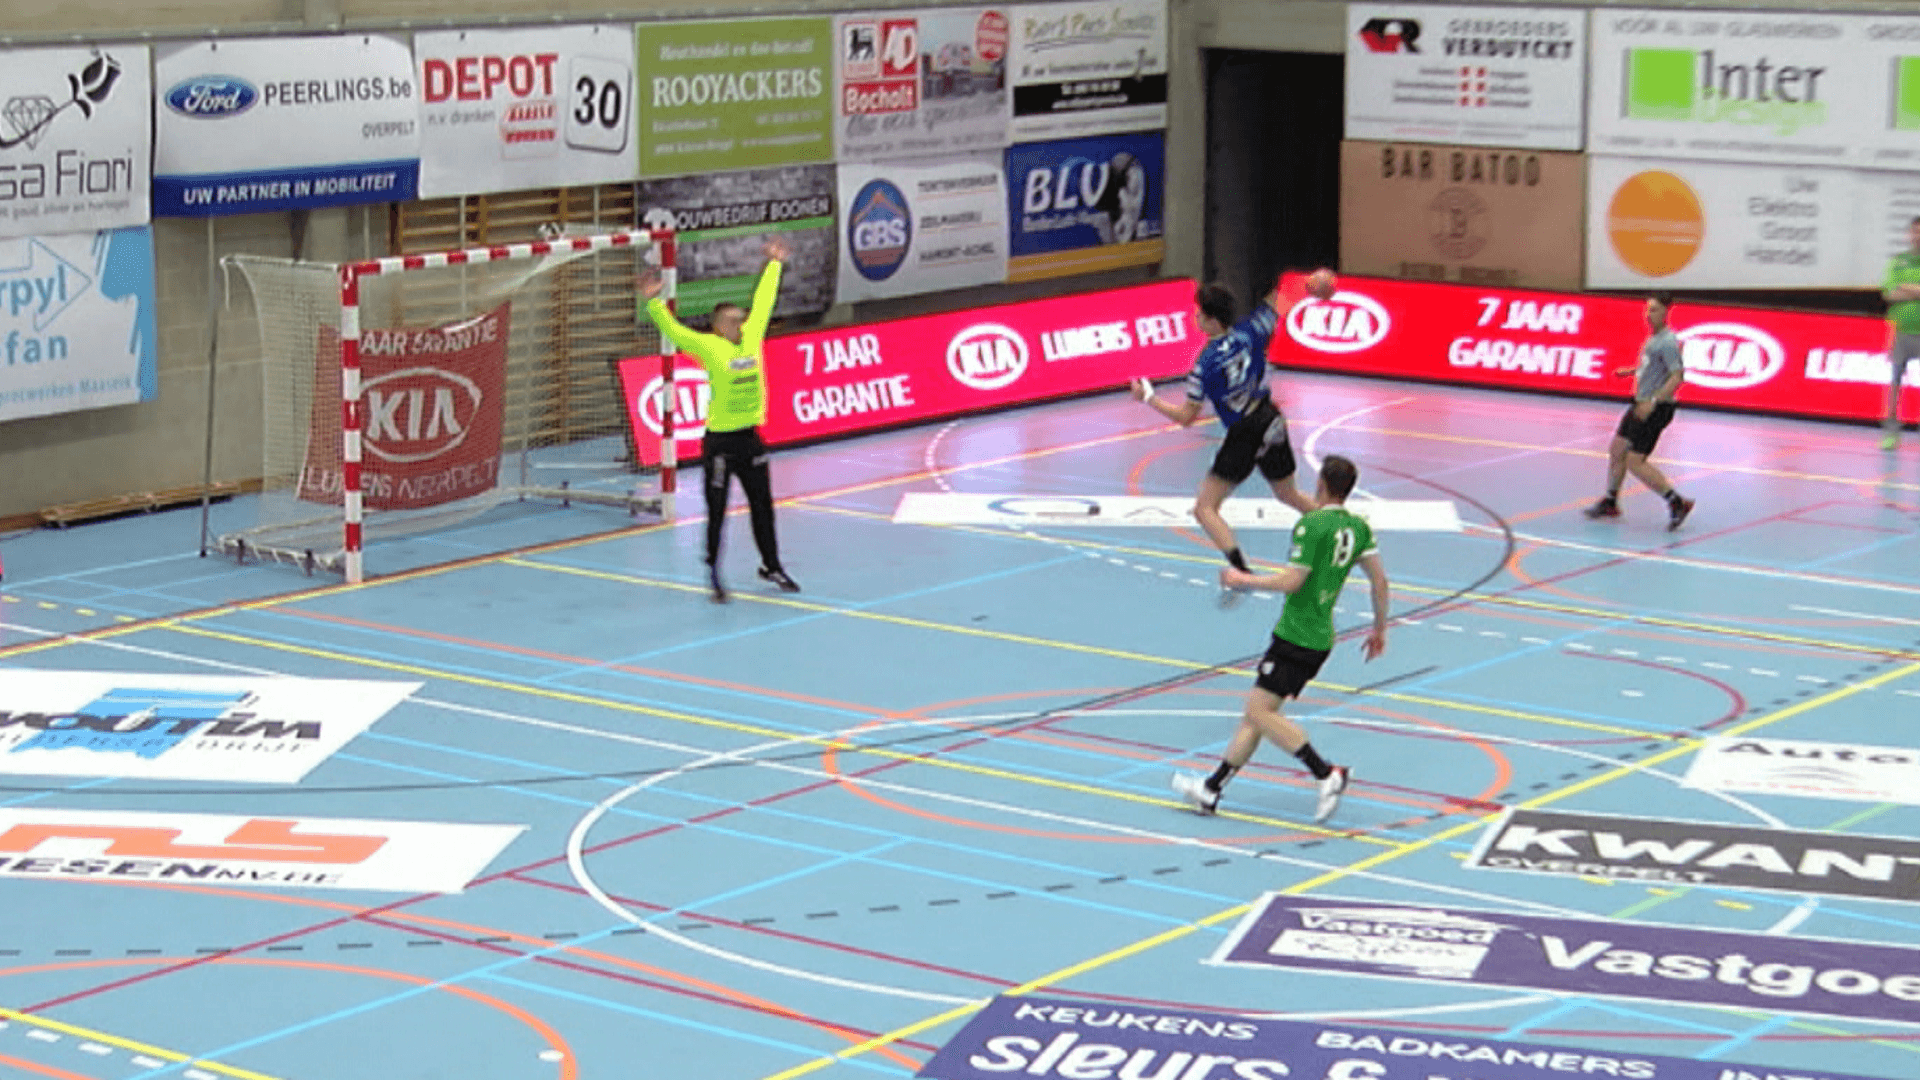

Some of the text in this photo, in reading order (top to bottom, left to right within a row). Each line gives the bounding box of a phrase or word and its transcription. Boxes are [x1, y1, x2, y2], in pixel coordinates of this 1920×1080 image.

[1443, 37, 1574, 59] VERDUYCKT
[265, 78, 412, 107] PEERLINGS.be
[424, 53, 621, 129] DEPOT 30
[653, 67, 822, 107] ROOYACKERS
[1699, 49, 1826, 103] Inter
[184, 85, 242, 112] Ford
[846, 85, 914, 113] Bocholt
[362, 121, 415, 140] OVERPELT
[57, 148, 132, 196] Fiori
[1381, 147, 1541, 187] BAR BATOO
[184, 173, 397, 205] UW PARTNER IN MOBILITEIT
[1024, 162, 1110, 214] BLV
[673, 198, 831, 230] OUWBEDRIJF BOONEN
[855, 219, 906, 251] GBS
[1135, 312, 1187, 347] PELT
[1300, 304, 1373, 342] KIA
[1478, 297, 1584, 335] 7 JAAR
[360, 331, 404, 355] AAR
[797, 334, 881, 375] 7 JAAR
[959, 338, 1018, 376] KIA
[1449, 336, 1605, 379] GARANTIE
[366, 388, 463, 441] KIA
[793, 374, 915, 423] GARANTIE
[307, 466, 392, 499] LUENS
[1331, 527, 1355, 567] 19
[1719, 742, 1912, 764] Auto
[1487, 857, 1714, 882] OVERPELT
[1496, 825, 1920, 881] KWAN
[1300, 908, 1496, 944] Vastgoed
[1541, 935, 1920, 1000] Vastgoe
[1014, 1002, 1259, 1040] KEUKENS
[1316, 1030, 1656, 1079] BADKAMERS
